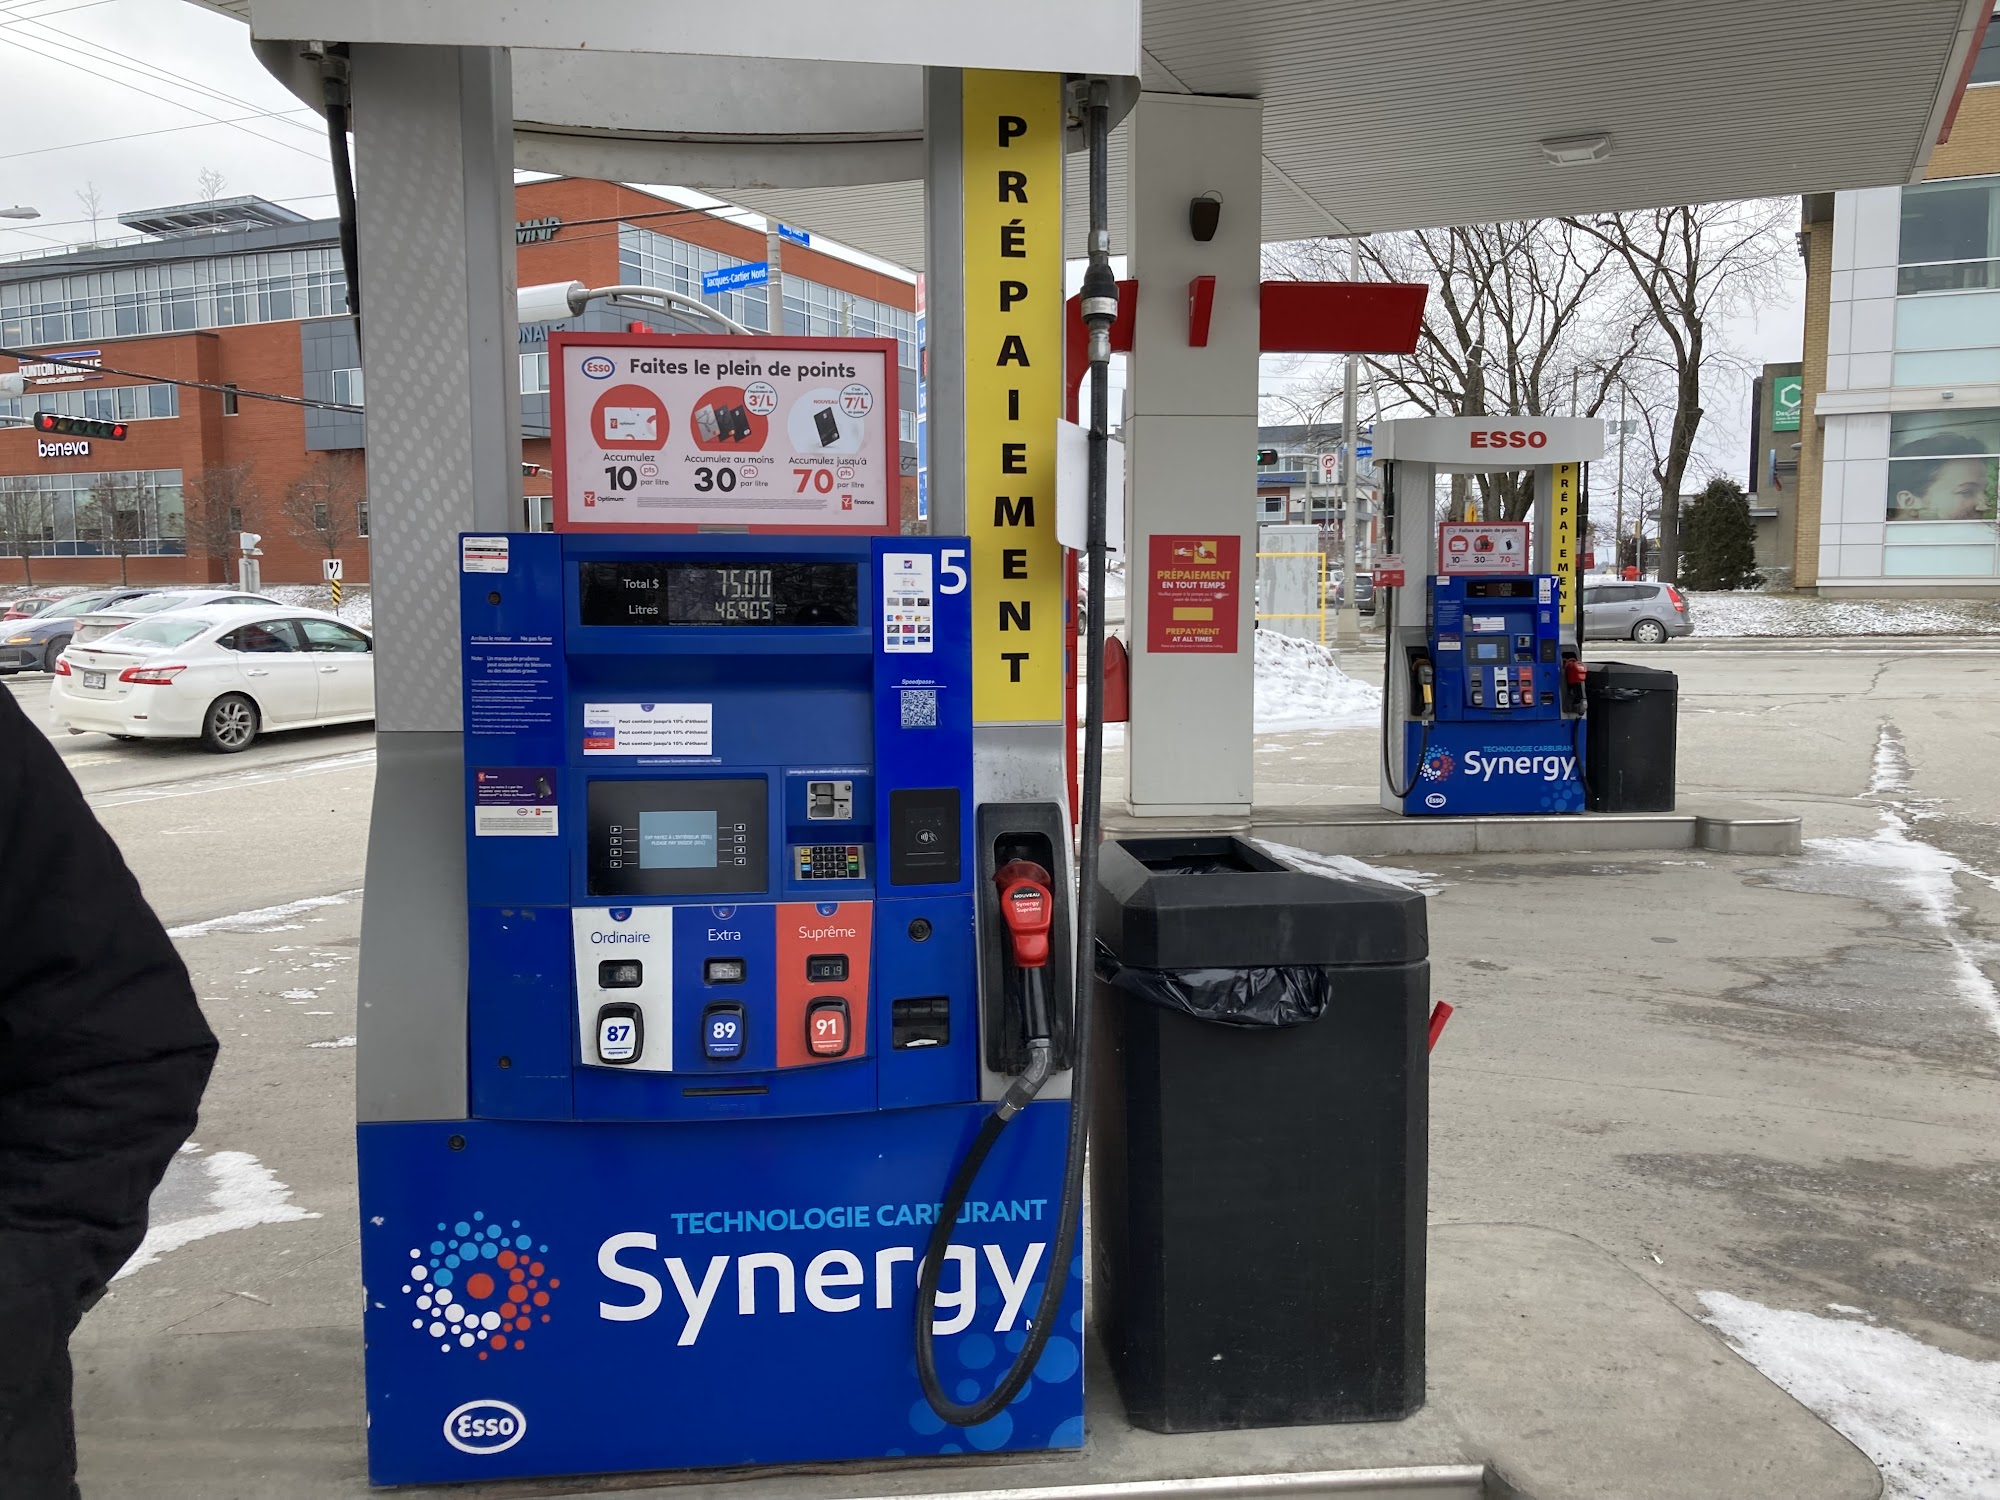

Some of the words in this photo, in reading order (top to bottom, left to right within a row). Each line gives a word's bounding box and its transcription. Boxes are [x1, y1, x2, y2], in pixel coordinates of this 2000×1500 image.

[707, 272, 750, 288] Jacques-Cartier
[751, 268, 766, 279] Nord
[587, 362, 611, 373] Esso
[630, 357, 688, 375] Faites
[694, 359, 710, 375] le
[717, 360, 762, 380] plein
[768, 361, 791, 377] de
[798, 361, 856, 382] points
[993, 115, 1035, 682] PRÉPAIEMENT
[1470, 430, 1547, 448] ESSO
[38, 439, 89, 457] beneva
[603, 453, 655, 462] Accumulez
[685, 455, 731, 463] Accumulez
[749, 456, 774, 464] moins
[789, 457, 834, 465] Accumulez
[836, 457, 867, 467] jusqu'à
[643, 466, 655, 474] pts
[743, 468, 755, 476] pts
[840, 469, 851, 477] pts
[605, 465, 637, 491] 10
[655, 478, 669, 486] litre
[694, 467, 737, 492] 30
[793, 469, 834, 494] 70
[1557, 464, 1569, 614] PRÉPAIEMENT
[1452, 556, 1460, 564] 10
[1474, 556, 1485, 564] 30
[1500, 555, 1511, 563] 70
[940, 549, 967, 595] 5
[1157, 567, 1231, 580] PRÉPAIEMENT
[624, 579, 650, 589] Total
[652, 578, 660, 590] $
[716, 569, 772, 598] 75.00
[1162, 581, 1174, 589] EN
[1176, 581, 1197, 589] TOUT
[1199, 581, 1226, 589] TEMPS
[1551, 576, 1560, 588] 7
[628, 604, 659, 615] Litres
[1165, 627, 1220, 635] PREPAYMENT
[1483, 745, 1532, 753] TECHNOLOGIE
[1533, 744, 1576, 752] CARBURAN
[1464, 750, 1577, 782] Synergy
[1428, 796, 1444, 804] Esso
[590, 931, 651, 944] Ordinaire
[708, 928, 741, 941] Extra
[798, 925, 856, 941] Suprême
[713, 1022, 736, 1039] 89
[816, 1018, 837, 1036] 91
[607, 1026, 630, 1042] 87
[671, 1206, 870, 1235] TECHNOLOGIE
[597, 1231, 1046, 1346] Synergy
[457, 1415, 514, 1438] Esso
